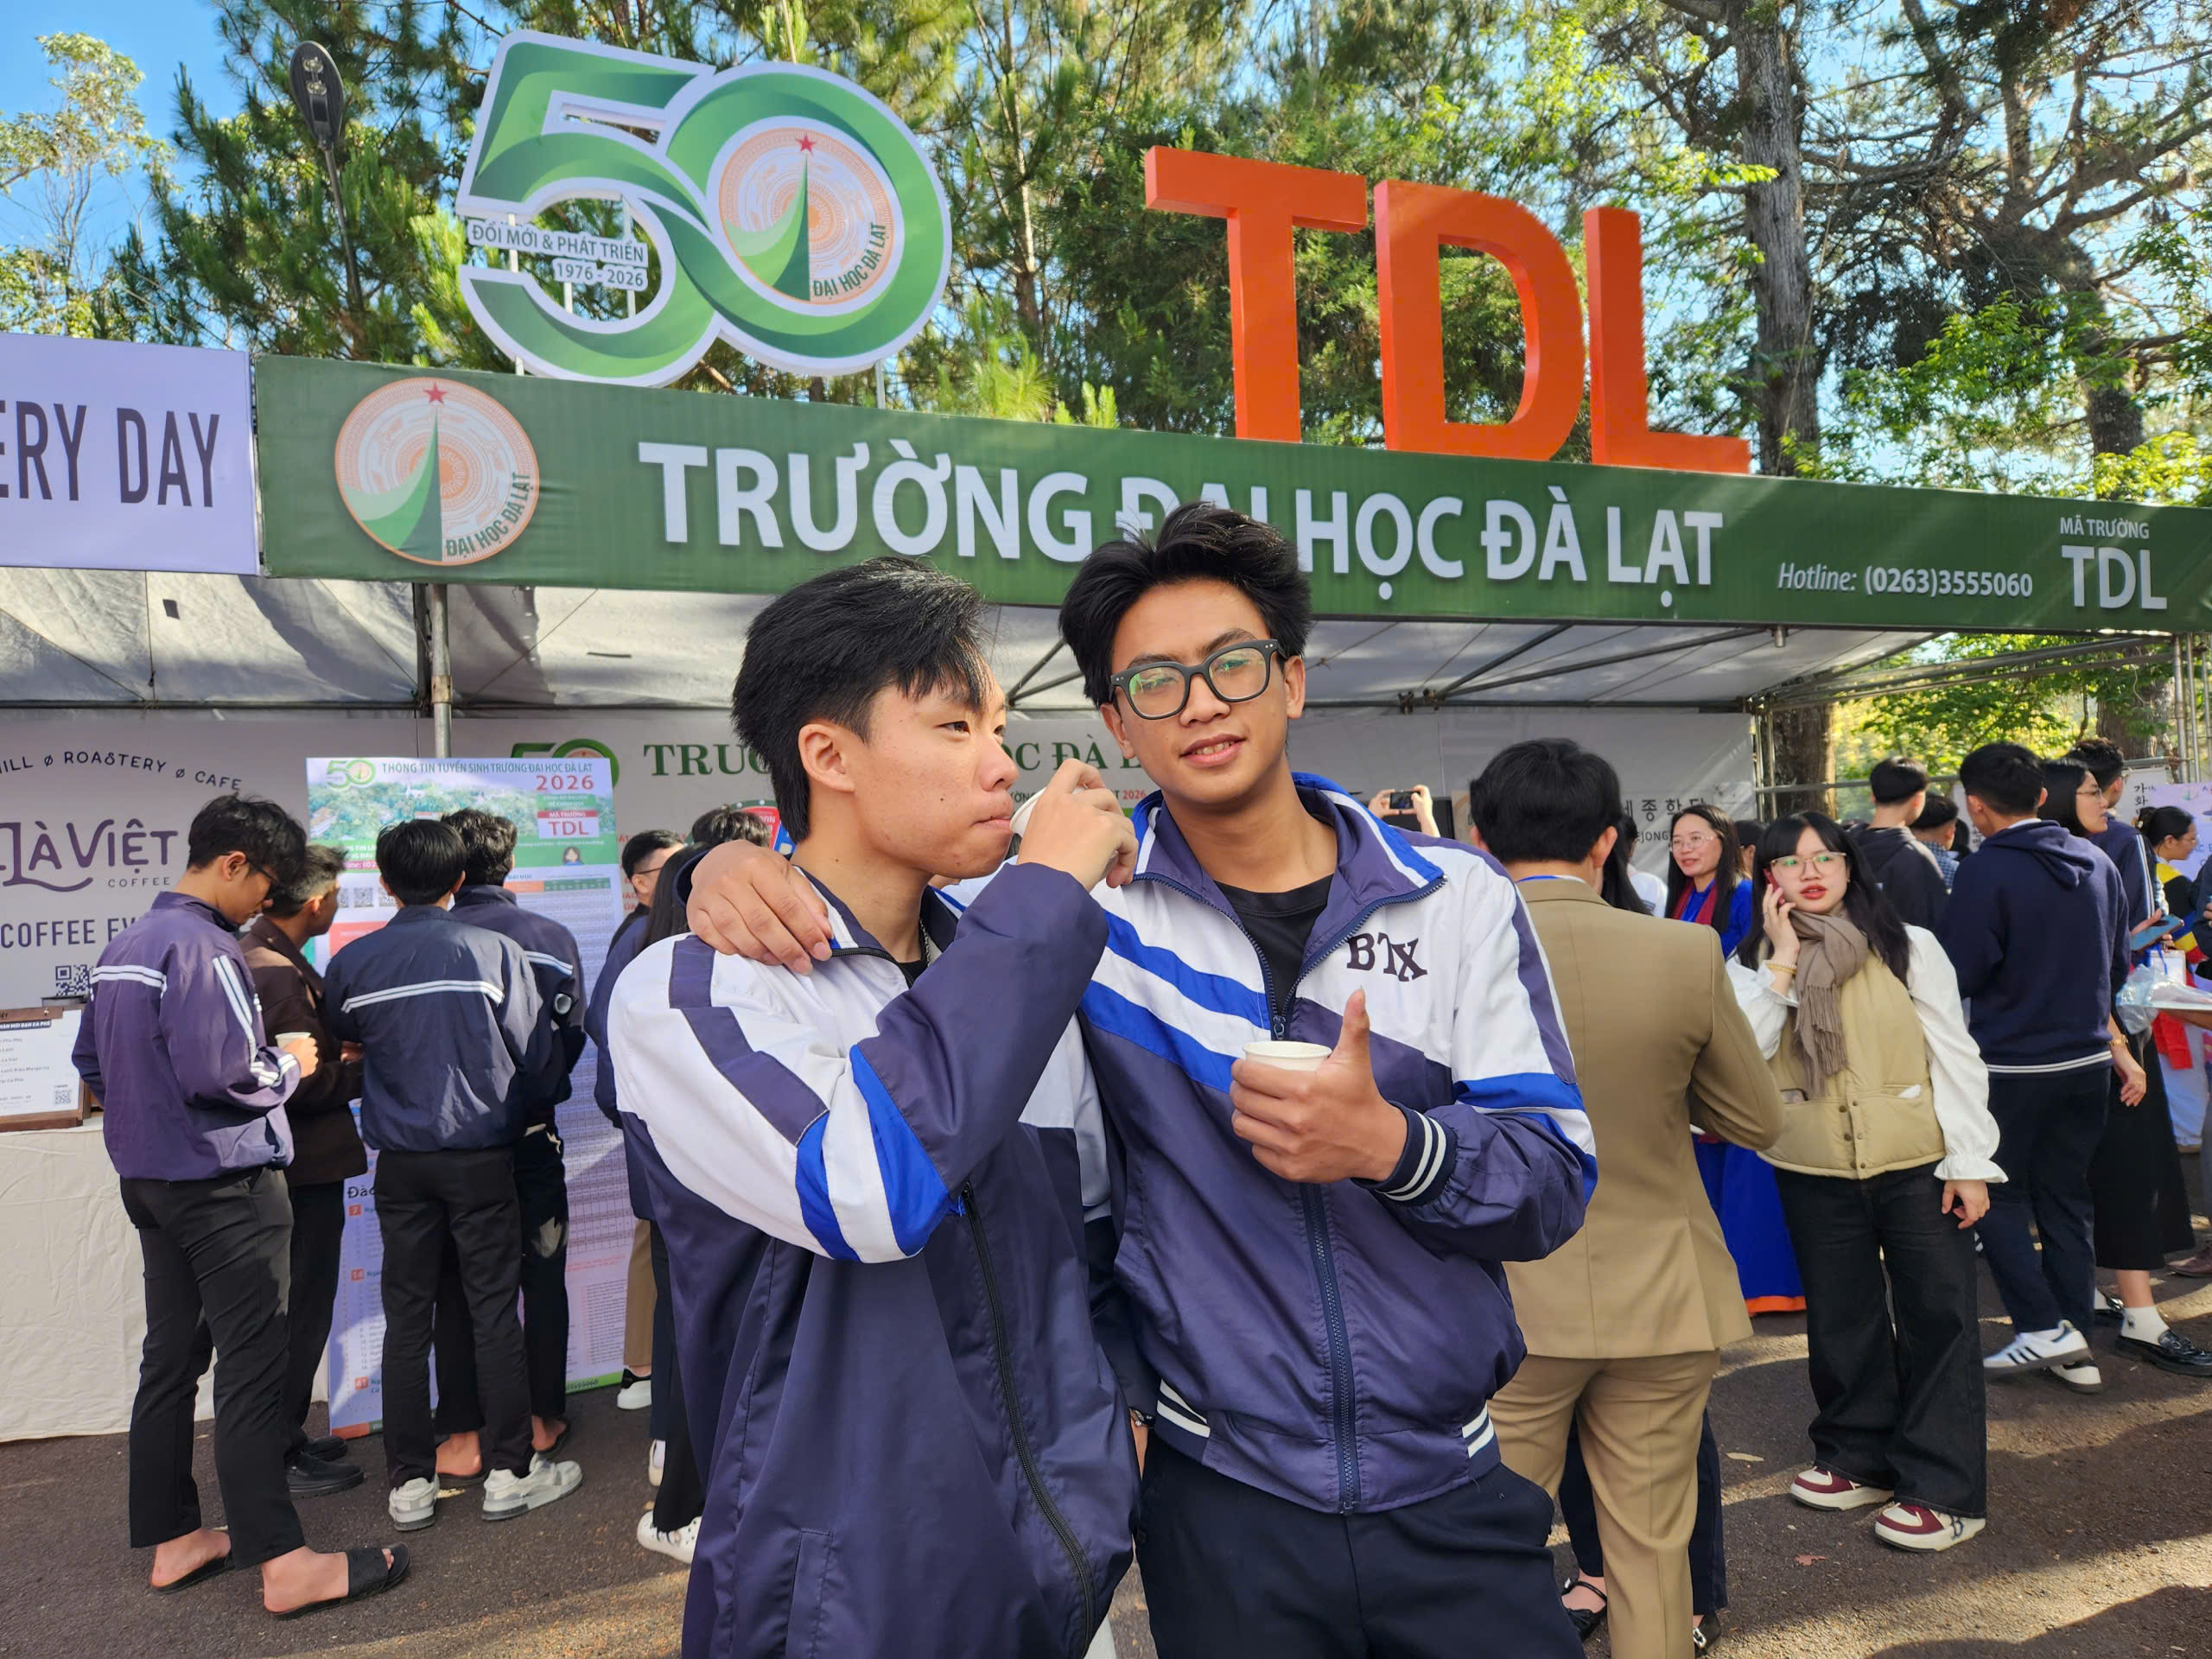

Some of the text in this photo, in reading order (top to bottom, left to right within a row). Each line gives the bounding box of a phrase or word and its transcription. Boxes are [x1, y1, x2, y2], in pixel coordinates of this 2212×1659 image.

[472, 221, 501, 243] ĐỔI
[507, 223, 537, 248] MỚI
[557, 232, 598, 257] PHÁT
[601, 239, 644, 263] TRIỂN
[557, 262, 594, 281] 1976
[607, 269, 644, 287] 2026
[1145, 145, 1751, 475] TDL
[0, 400, 220, 508] RY DAY
[639, 439, 1092, 563] TRƯỜNG
[1294, 486, 1464, 601] HỌC
[1481, 486, 1587, 582] ĐÀ
[1607, 506, 1723, 608] LẠT
[2060, 515, 2149, 540] MÃ TRƯỜNG
[1777, 563, 2033, 598] Hotline: (0263)3555060
[2061, 544, 2168, 610] TDL
[0, 756, 33, 774] ILL
[64, 752, 167, 772] ROASTERY
[420, 763, 435, 773] TIN
[469, 763, 489, 773] SINH
[536, 774, 594, 791] 2026
[1122, 790, 1147, 800] 2026
[549, 821, 588, 836] TDL
[108, 877, 170, 888] COFFEE
[1, 919, 95, 949] COFFEE
